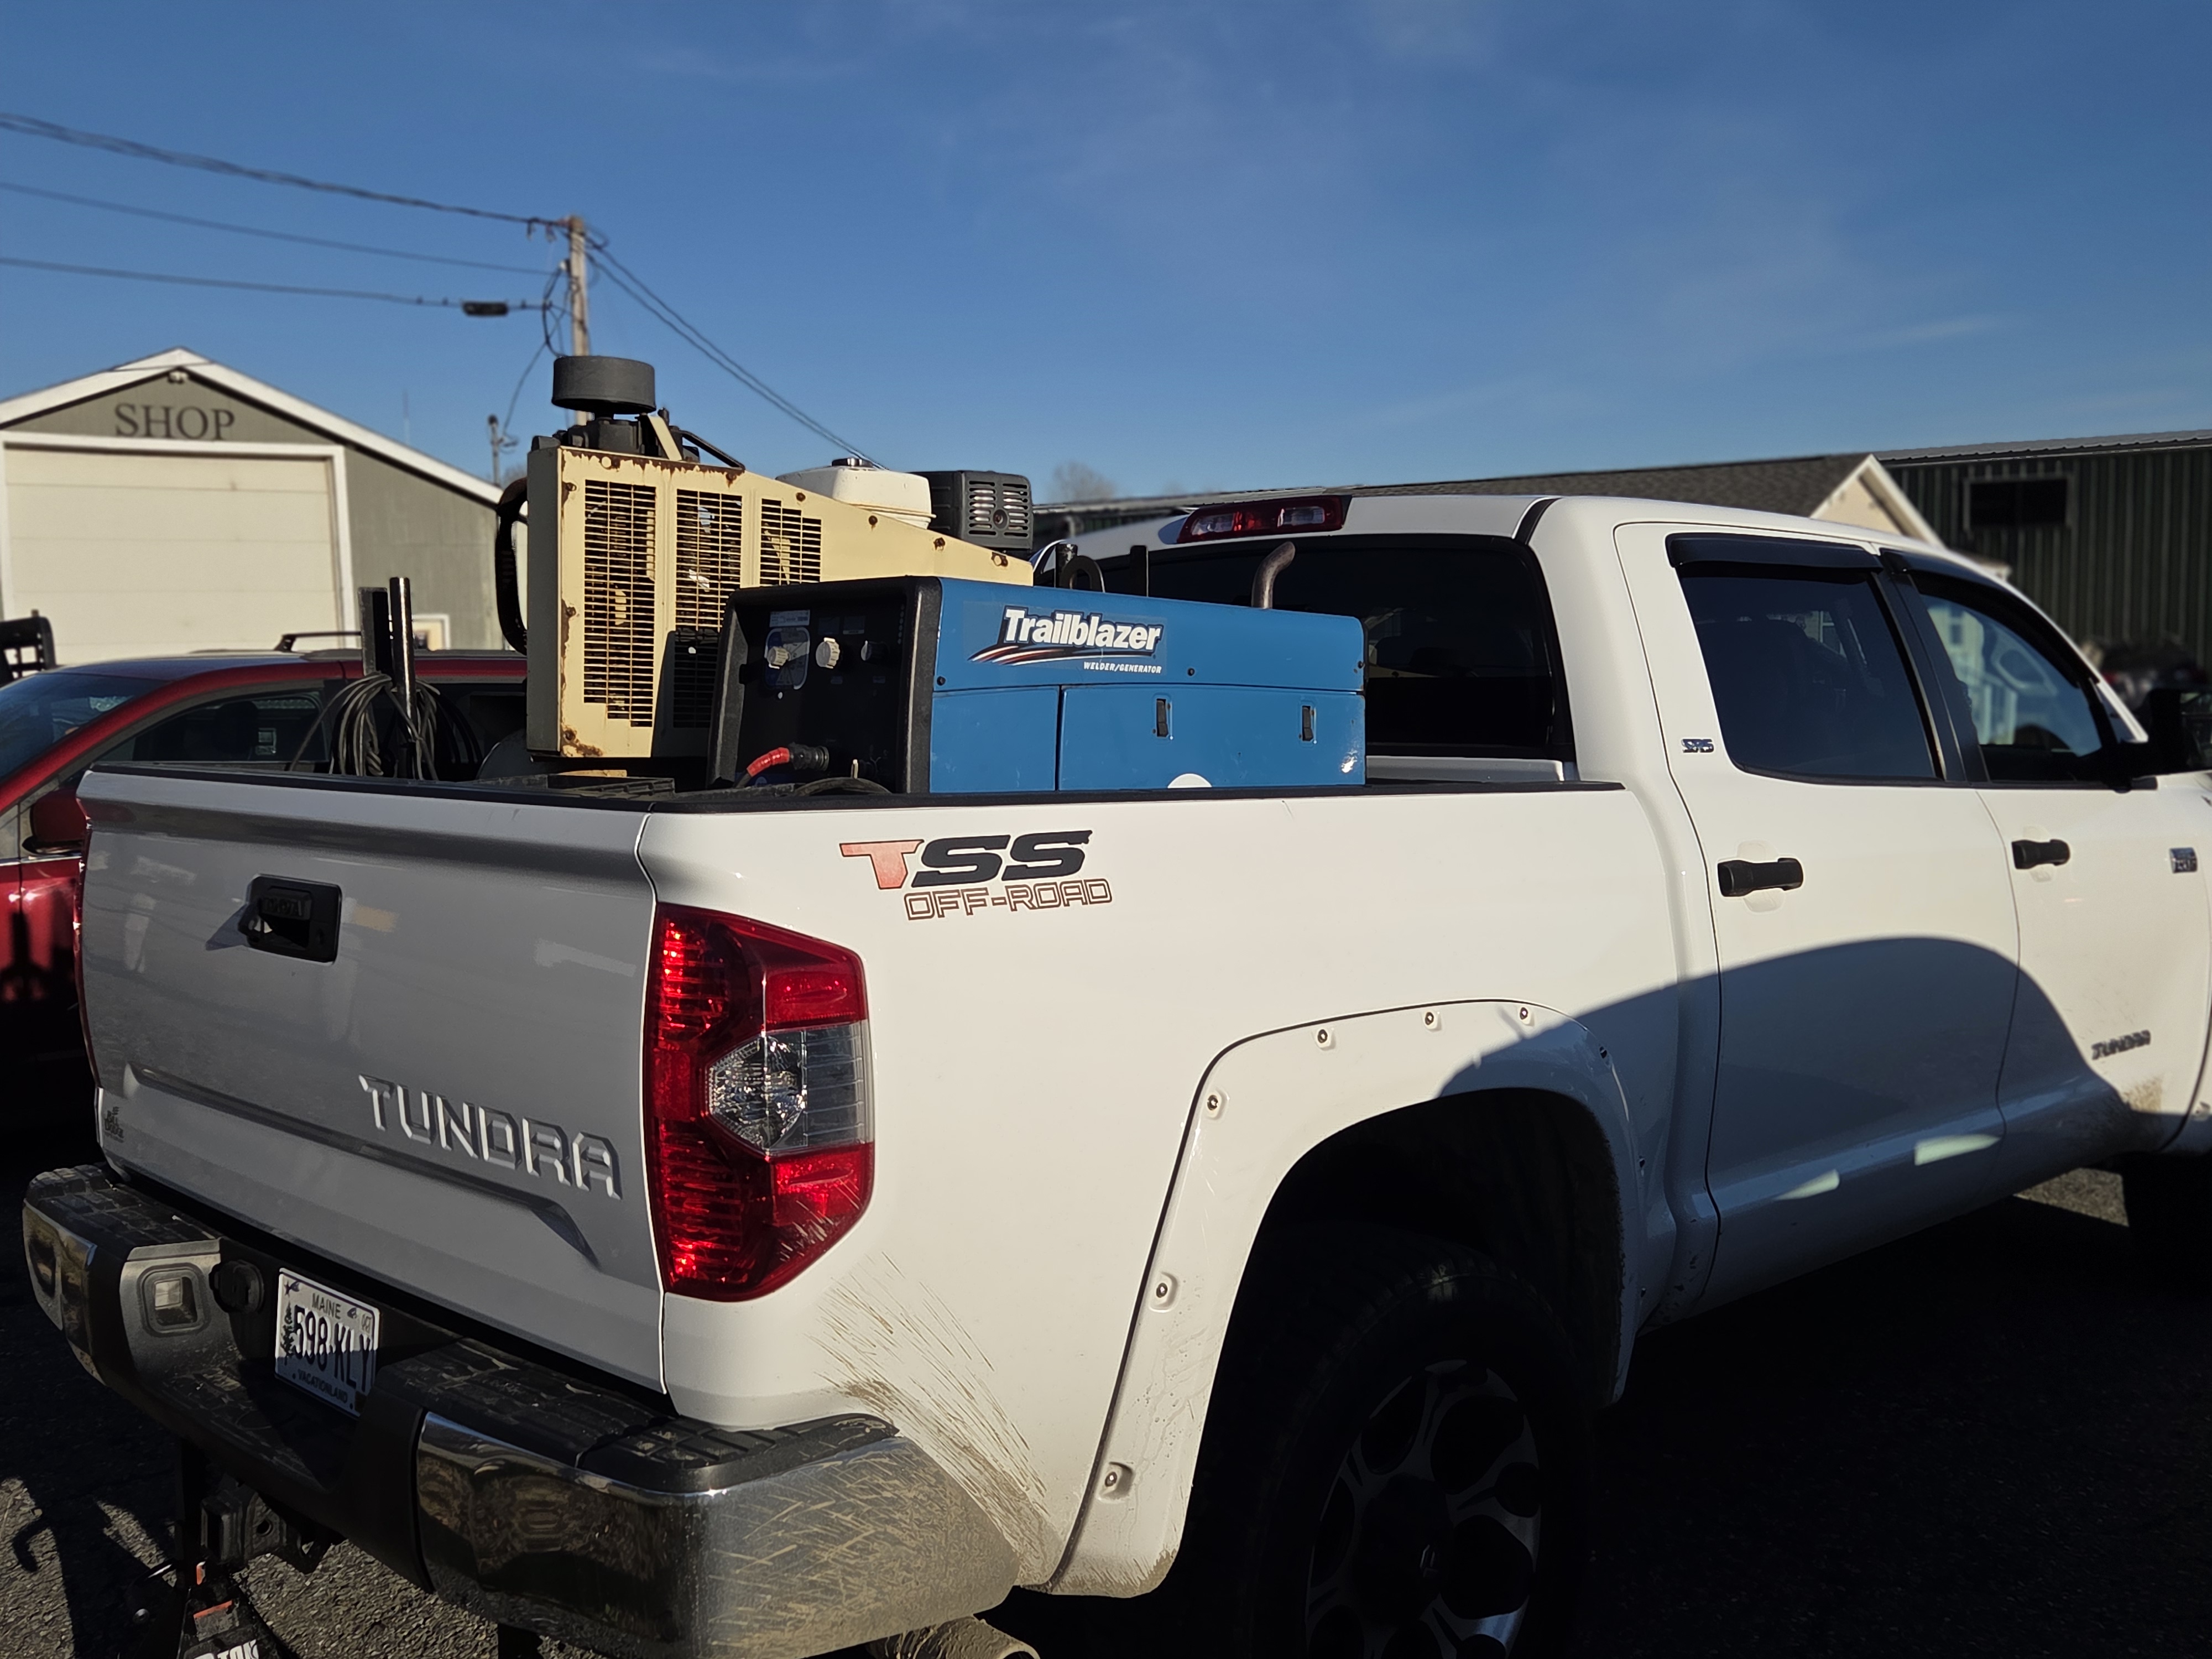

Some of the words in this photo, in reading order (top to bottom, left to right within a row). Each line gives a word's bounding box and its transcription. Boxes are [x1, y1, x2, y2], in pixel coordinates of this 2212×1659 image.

[114, 402, 235, 441] SHOP
[1001, 607, 1162, 651] Trailblazer
[1084, 661, 1162, 674] WELDER/GENERATOR
[839, 830, 1093, 889] TSS
[904, 878, 1113, 921] OFF-ROAD
[358, 1074, 623, 1200] TUNDRA
[311, 1292, 342, 1320] MAINE
